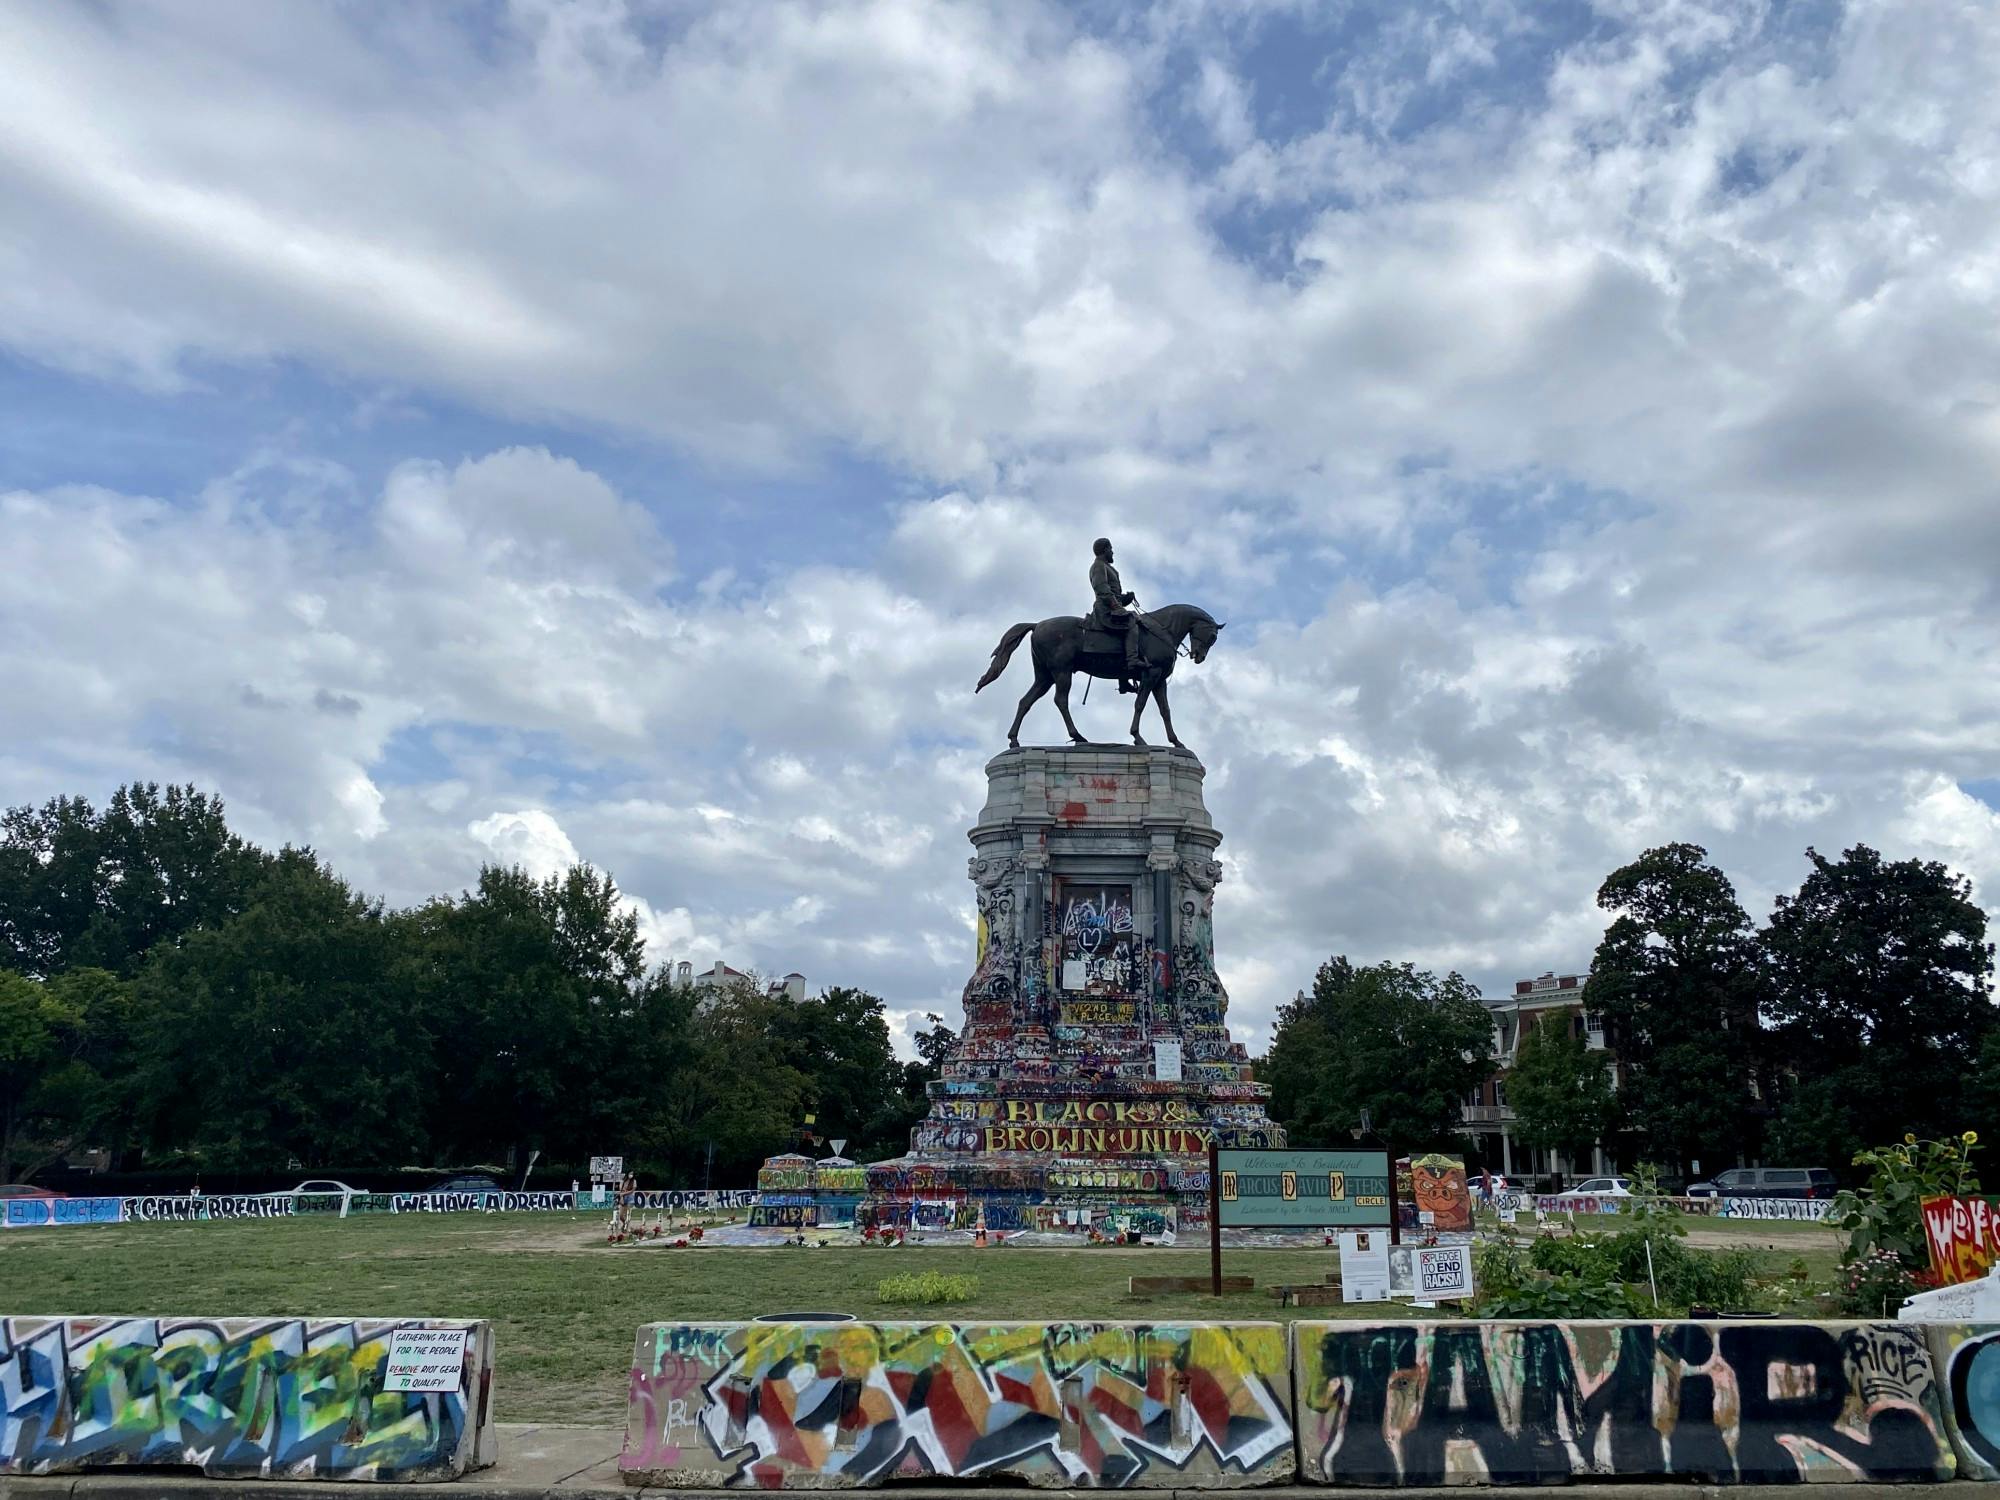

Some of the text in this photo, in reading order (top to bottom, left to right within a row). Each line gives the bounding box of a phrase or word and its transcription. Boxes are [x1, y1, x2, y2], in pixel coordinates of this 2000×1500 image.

[1005, 1100, 1156, 1121] BLACK
[1162, 1100, 1188, 1122] &
[985, 1128, 1105, 1152] BROWN
[1119, 1128, 1213, 1152] UNITY
[1312, 1158, 1363, 1169] Beautiful
[1332, 1175, 1386, 1196] PETERS
[392, 1193, 429, 1213] WE
[430, 1193, 479, 1212] HAVE
[483, 1193, 501, 1212] A
[502, 1191, 574, 1212] DREAM
[649, 1190, 709, 1208] MORE
[1357, 1197, 1385, 1205] CIRCLE
[8, 1200, 49, 1223] END
[206, 1196, 295, 1219] BREATHE
[1430, 1251, 1459, 1263] PLEDGE
[1424, 1262, 1461, 1273] TO END
[1425, 1273, 1462, 1289] RACISM
[396, 1333, 463, 1341] GATHERING PLACE
[396, 1346, 460, 1355] FOR THE PEOPLE
[389, 1365, 461, 1374] REMOVE RIOT GEAR
[400, 1378, 411, 1387] TO
